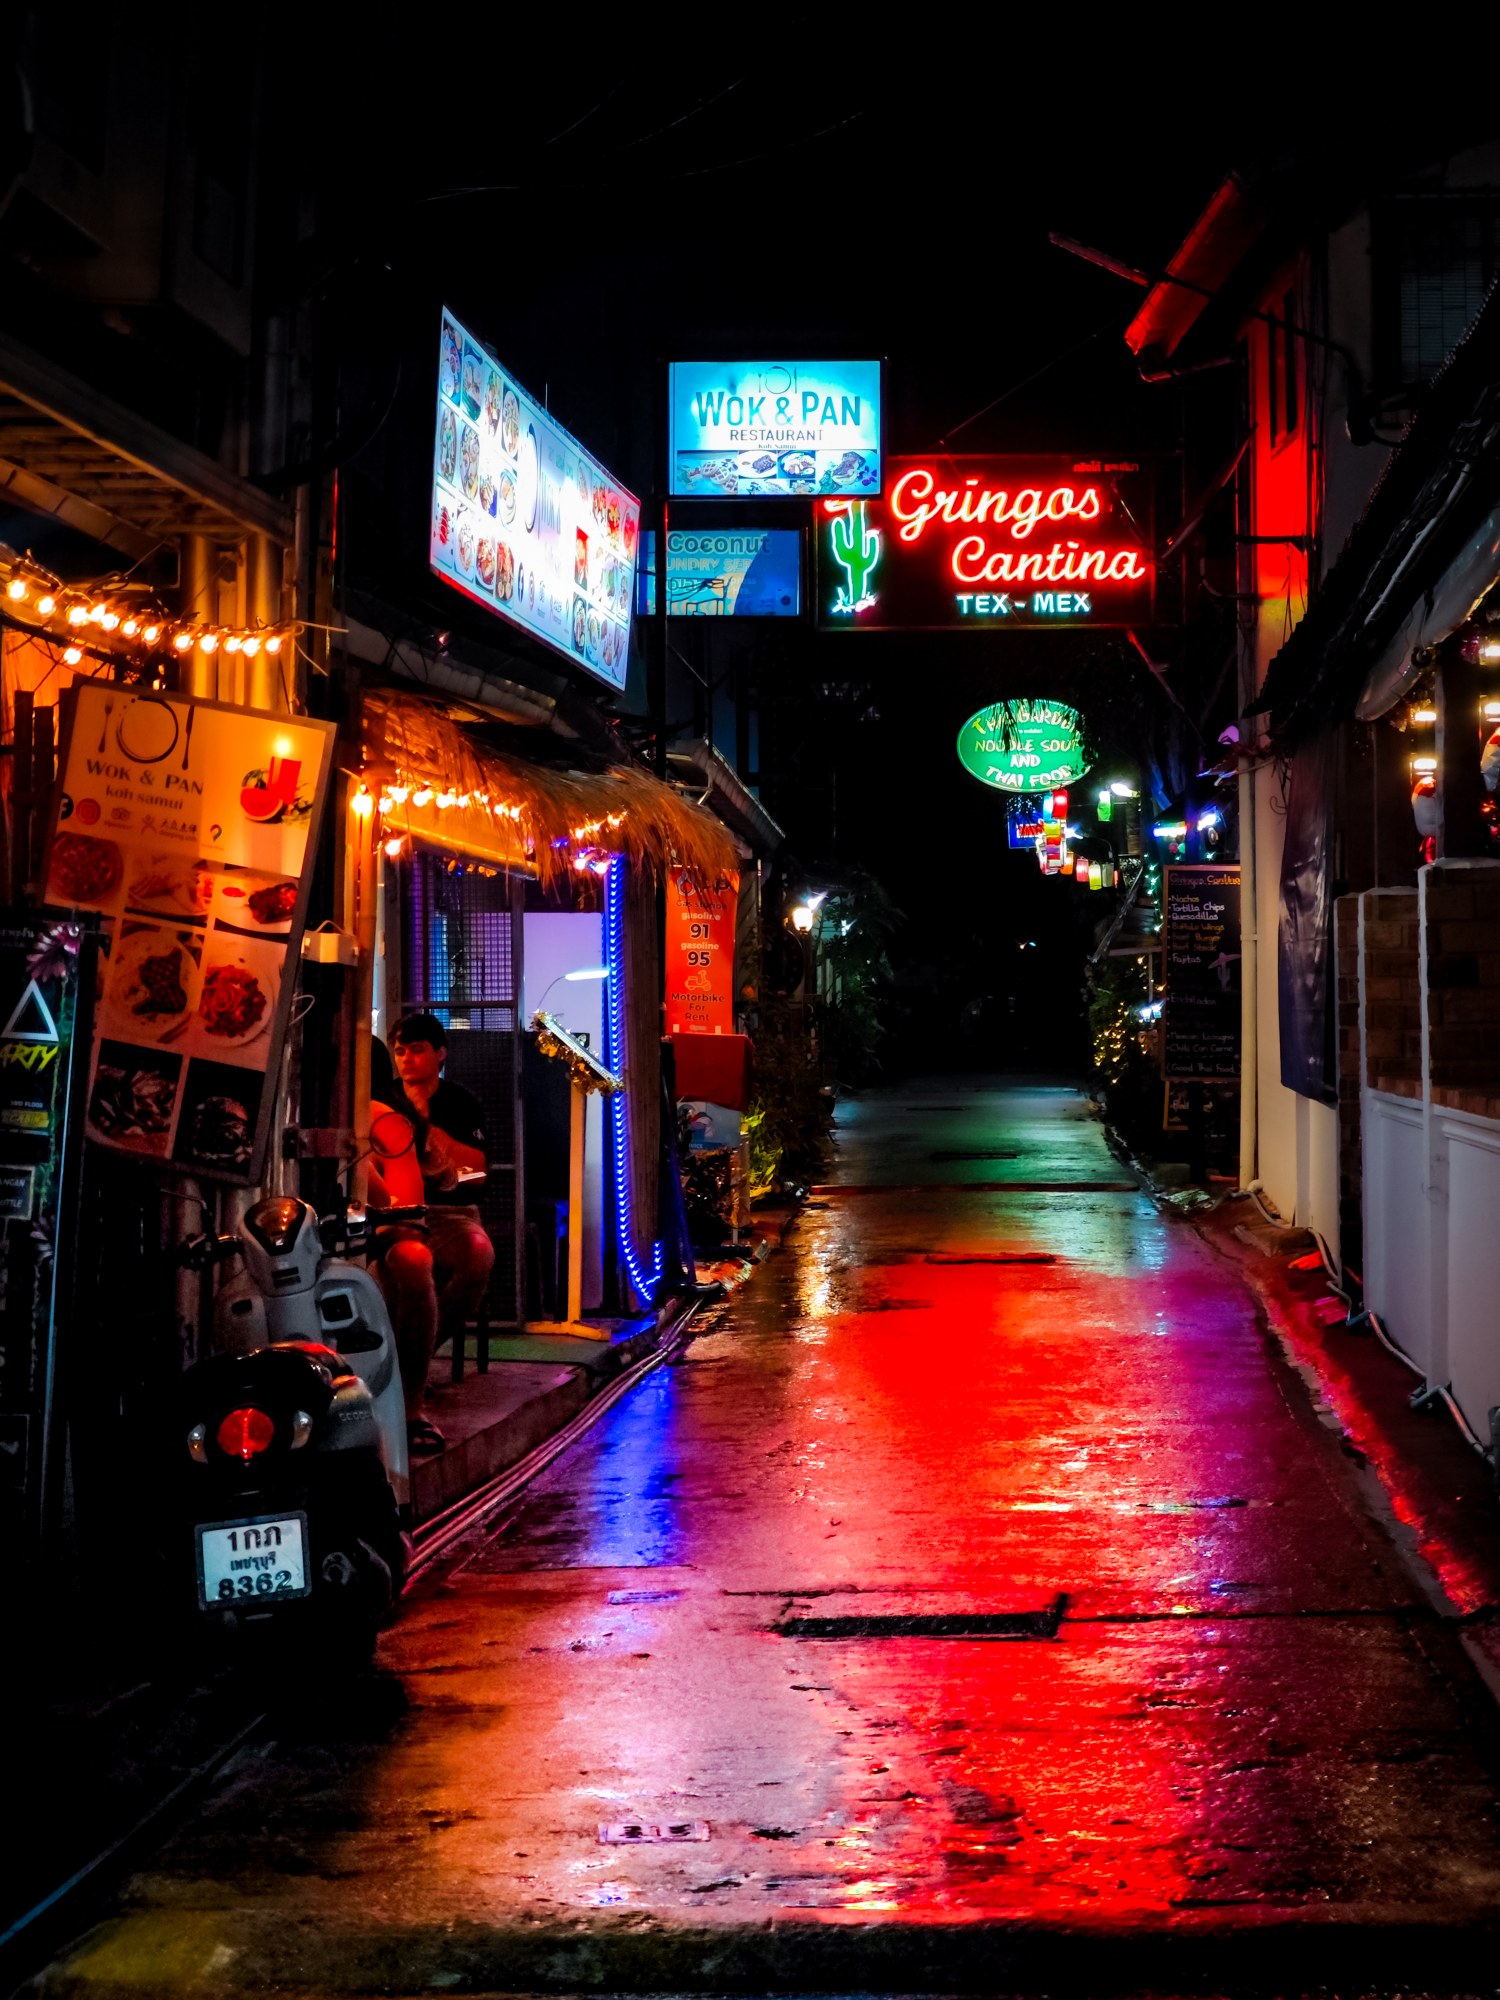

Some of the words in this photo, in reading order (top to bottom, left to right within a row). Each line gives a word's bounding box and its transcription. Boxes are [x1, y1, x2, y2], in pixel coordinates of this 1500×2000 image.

[695, 391, 766, 427] WOK
[774, 396, 794, 426] &
[800, 391, 861, 426] PAN
[729, 429, 824, 441] RESTAURANT
[890, 469, 1102, 543] Gringos
[667, 531, 771, 555] Coconut
[951, 534, 1146, 583] Cantina
[956, 593, 1009, 615] TEX
[1033, 592, 1092, 614] MEX
[1010, 753, 1041, 768] AND
[86, 759, 131, 781] WOK
[139, 769, 155, 785] &
[165, 773, 204, 796] PAN
[986, 766, 1024, 787] THAI
[1029, 765, 1074, 787] FOOD
[1171, 894, 1200, 903] Nachos
[1171, 902, 1200, 913] Tortilla
[1202, 901, 1225, 914] Chips
[1171, 911, 1219, 921] Quesadillas
[690, 923, 709, 939] 91
[681, 941, 720, 951] gasoline
[687, 951, 711, 967] 95
[1171, 952, 1202, 965] Fajitas
[671, 993, 725, 1002] Motorbike
[689, 1003, 706, 1011] For
[685, 1012, 709, 1021] Rent
[218, 1570, 294, 1599] 8362
